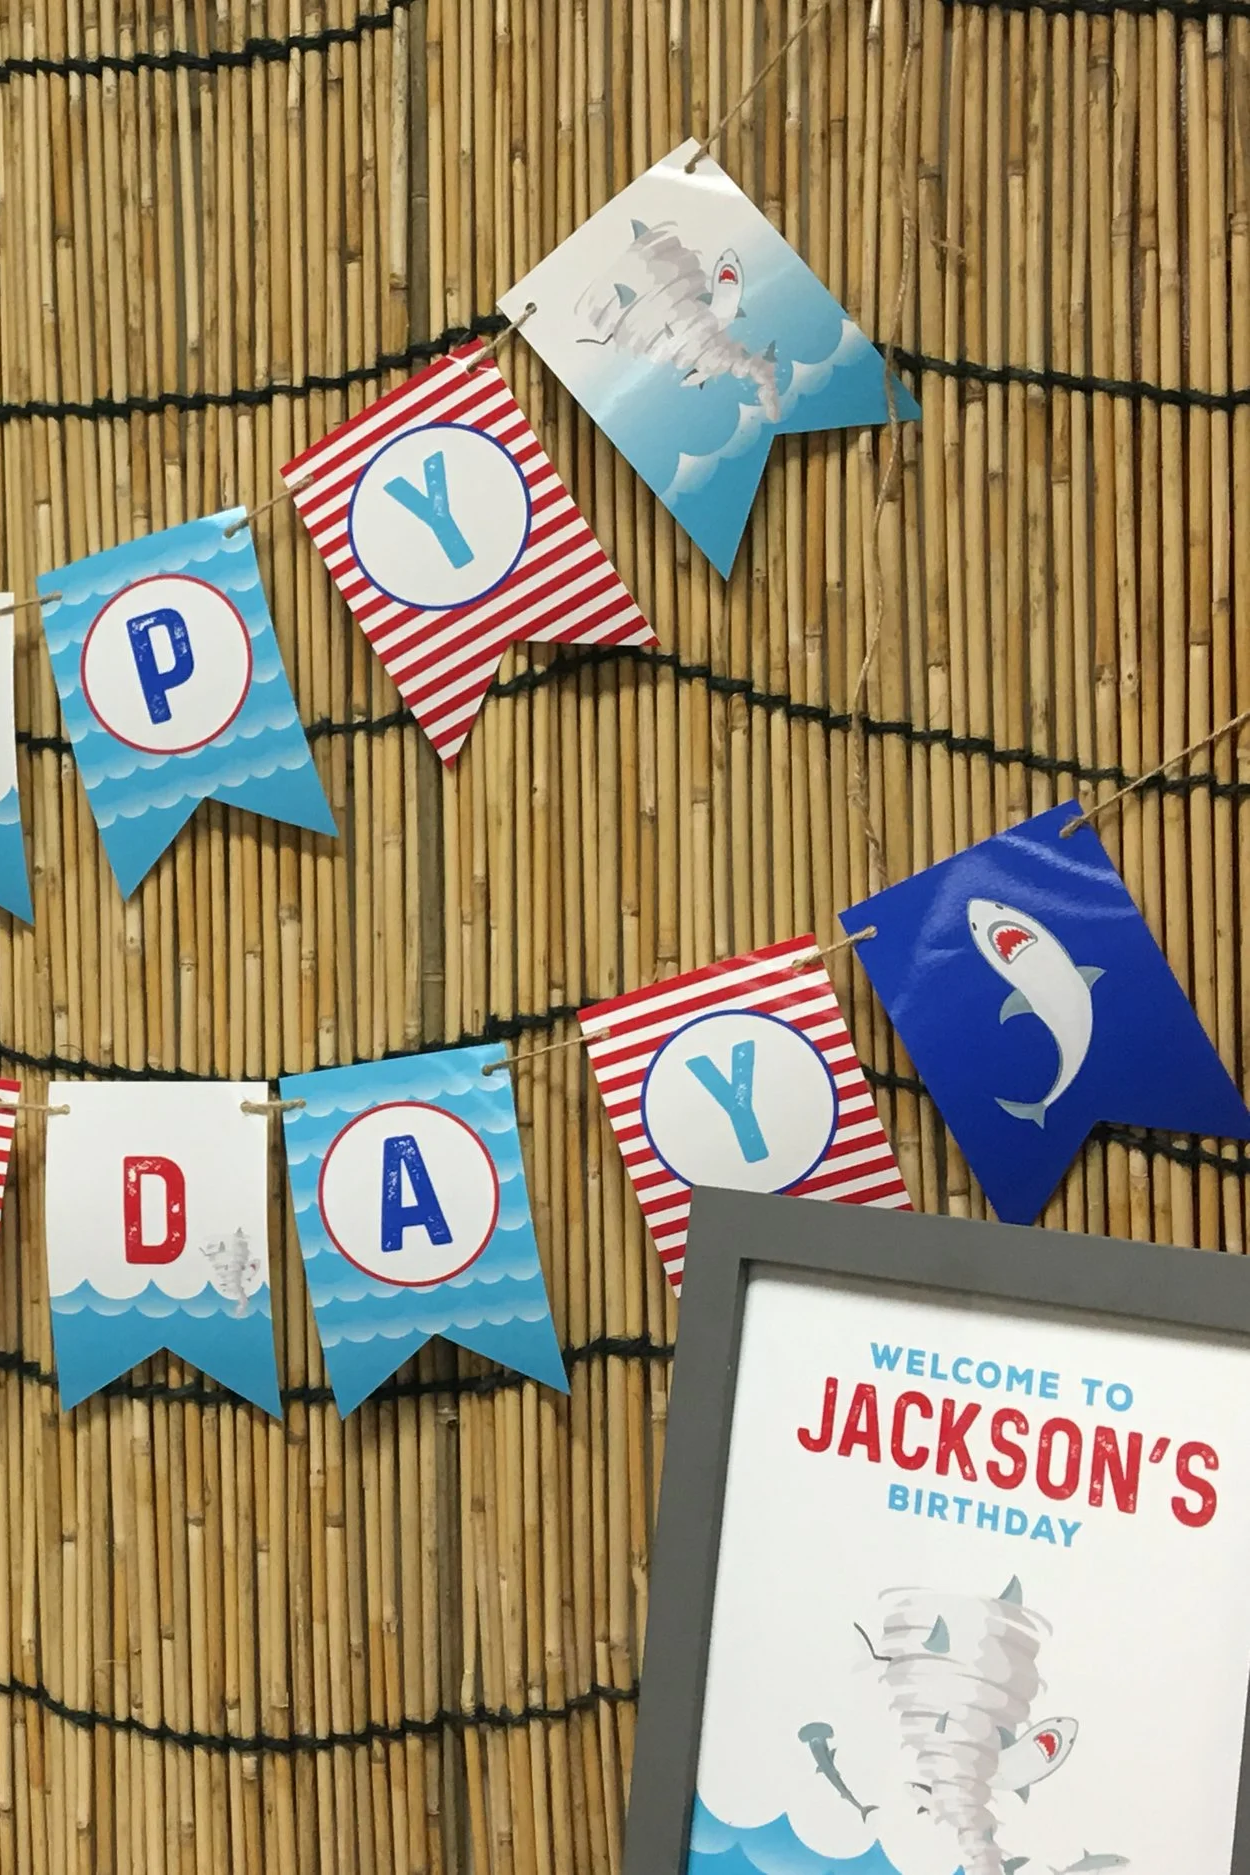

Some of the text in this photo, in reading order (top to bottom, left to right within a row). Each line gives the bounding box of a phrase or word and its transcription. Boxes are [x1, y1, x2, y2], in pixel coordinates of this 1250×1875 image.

[870, 1342, 1134, 1412] WELCOME TO
[797, 1377, 1219, 1527] JACKSON'S
[888, 1484, 1082, 1547] BIRTHDAY
